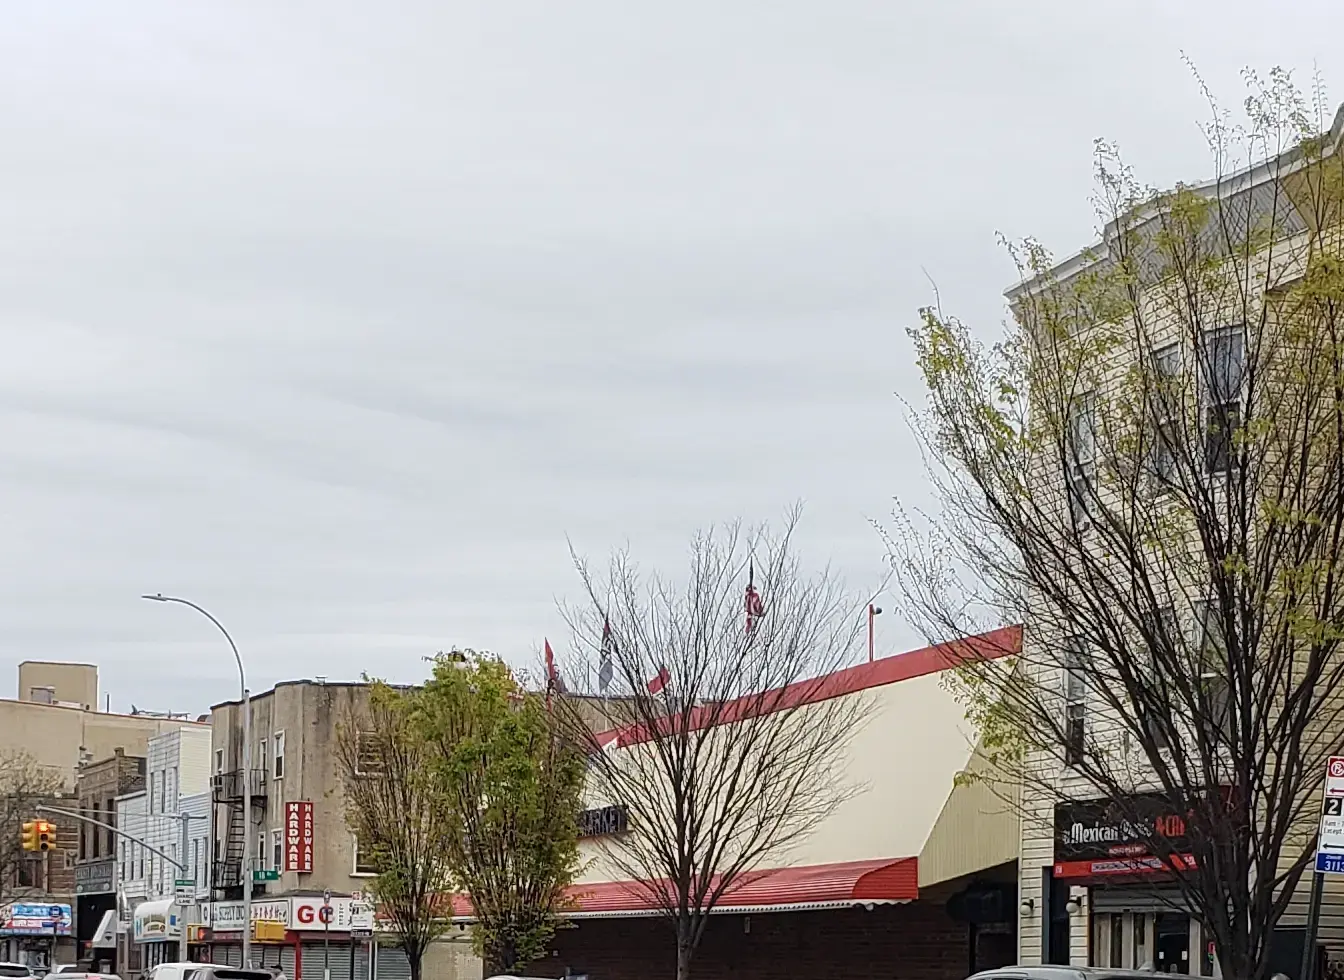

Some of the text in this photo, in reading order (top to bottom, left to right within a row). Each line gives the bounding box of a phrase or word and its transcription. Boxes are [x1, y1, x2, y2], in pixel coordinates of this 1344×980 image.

[1327, 798, 1339, 815] 2
[287, 803, 301, 870] HARDWARE
[303, 803, 313, 870] HARDWARE
[1071, 821, 1119, 844] Mexican
[1323, 827, 1343, 836] Except
